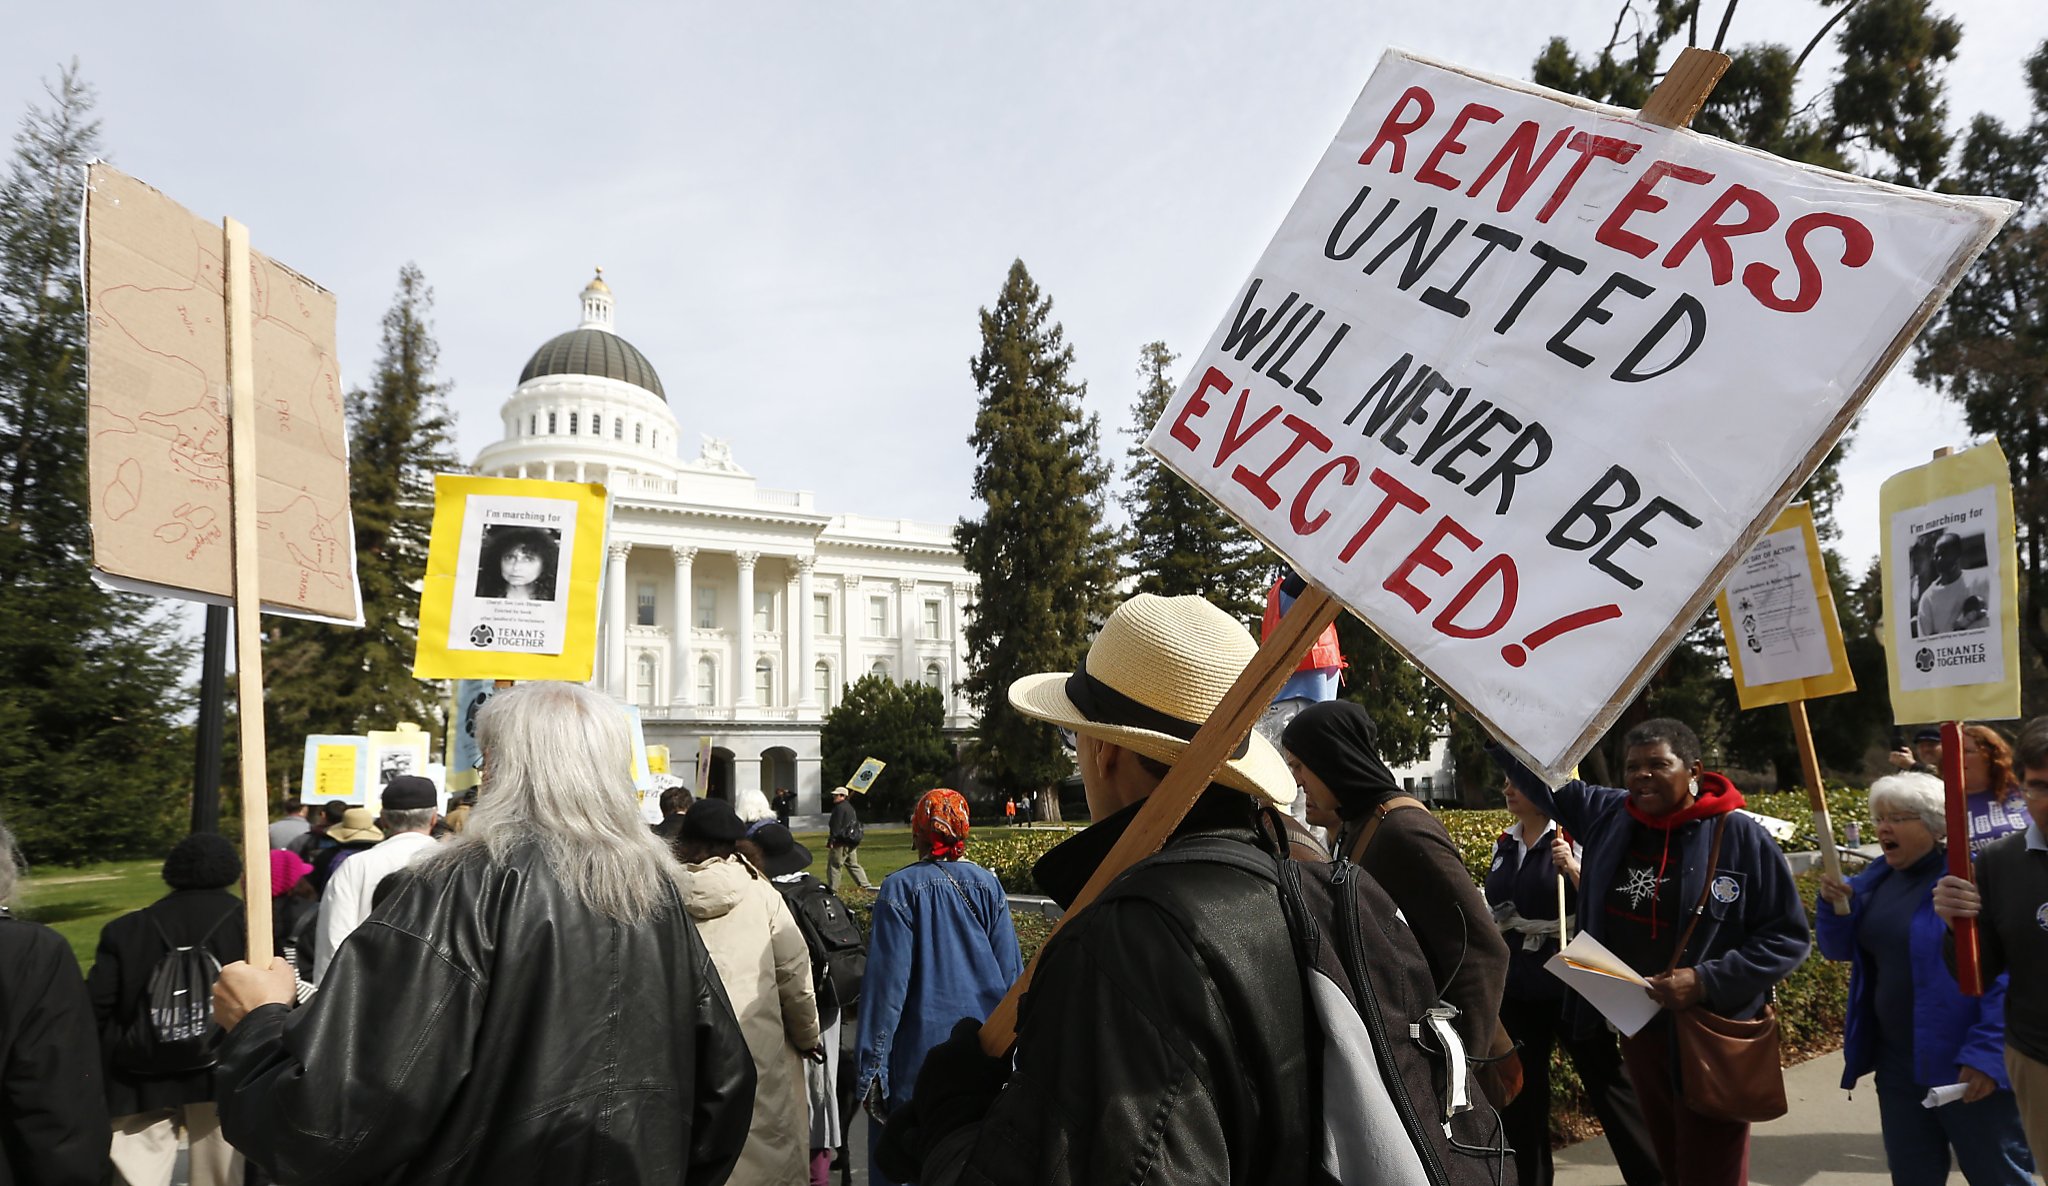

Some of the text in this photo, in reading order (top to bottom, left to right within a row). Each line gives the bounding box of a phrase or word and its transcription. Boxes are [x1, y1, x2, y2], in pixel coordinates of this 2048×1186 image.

[1359, 86, 1874, 313] RENTERS
[1324, 185, 1707, 383] UNITED
[275, 398, 291, 433] PRC
[1221, 279, 1703, 591] WILL NEVER BE
[486, 509, 561, 522] I'm marching for
[1170, 367, 1623, 667] EVICTED!
[1910, 508, 1983, 534] I'm marching for
[497, 637, 544, 648] TOGETHER
[498, 628, 545, 638] TENANTS
[1937, 643, 1985, 657] TENANTS
[1937, 653, 1986, 668] TOGETHER
